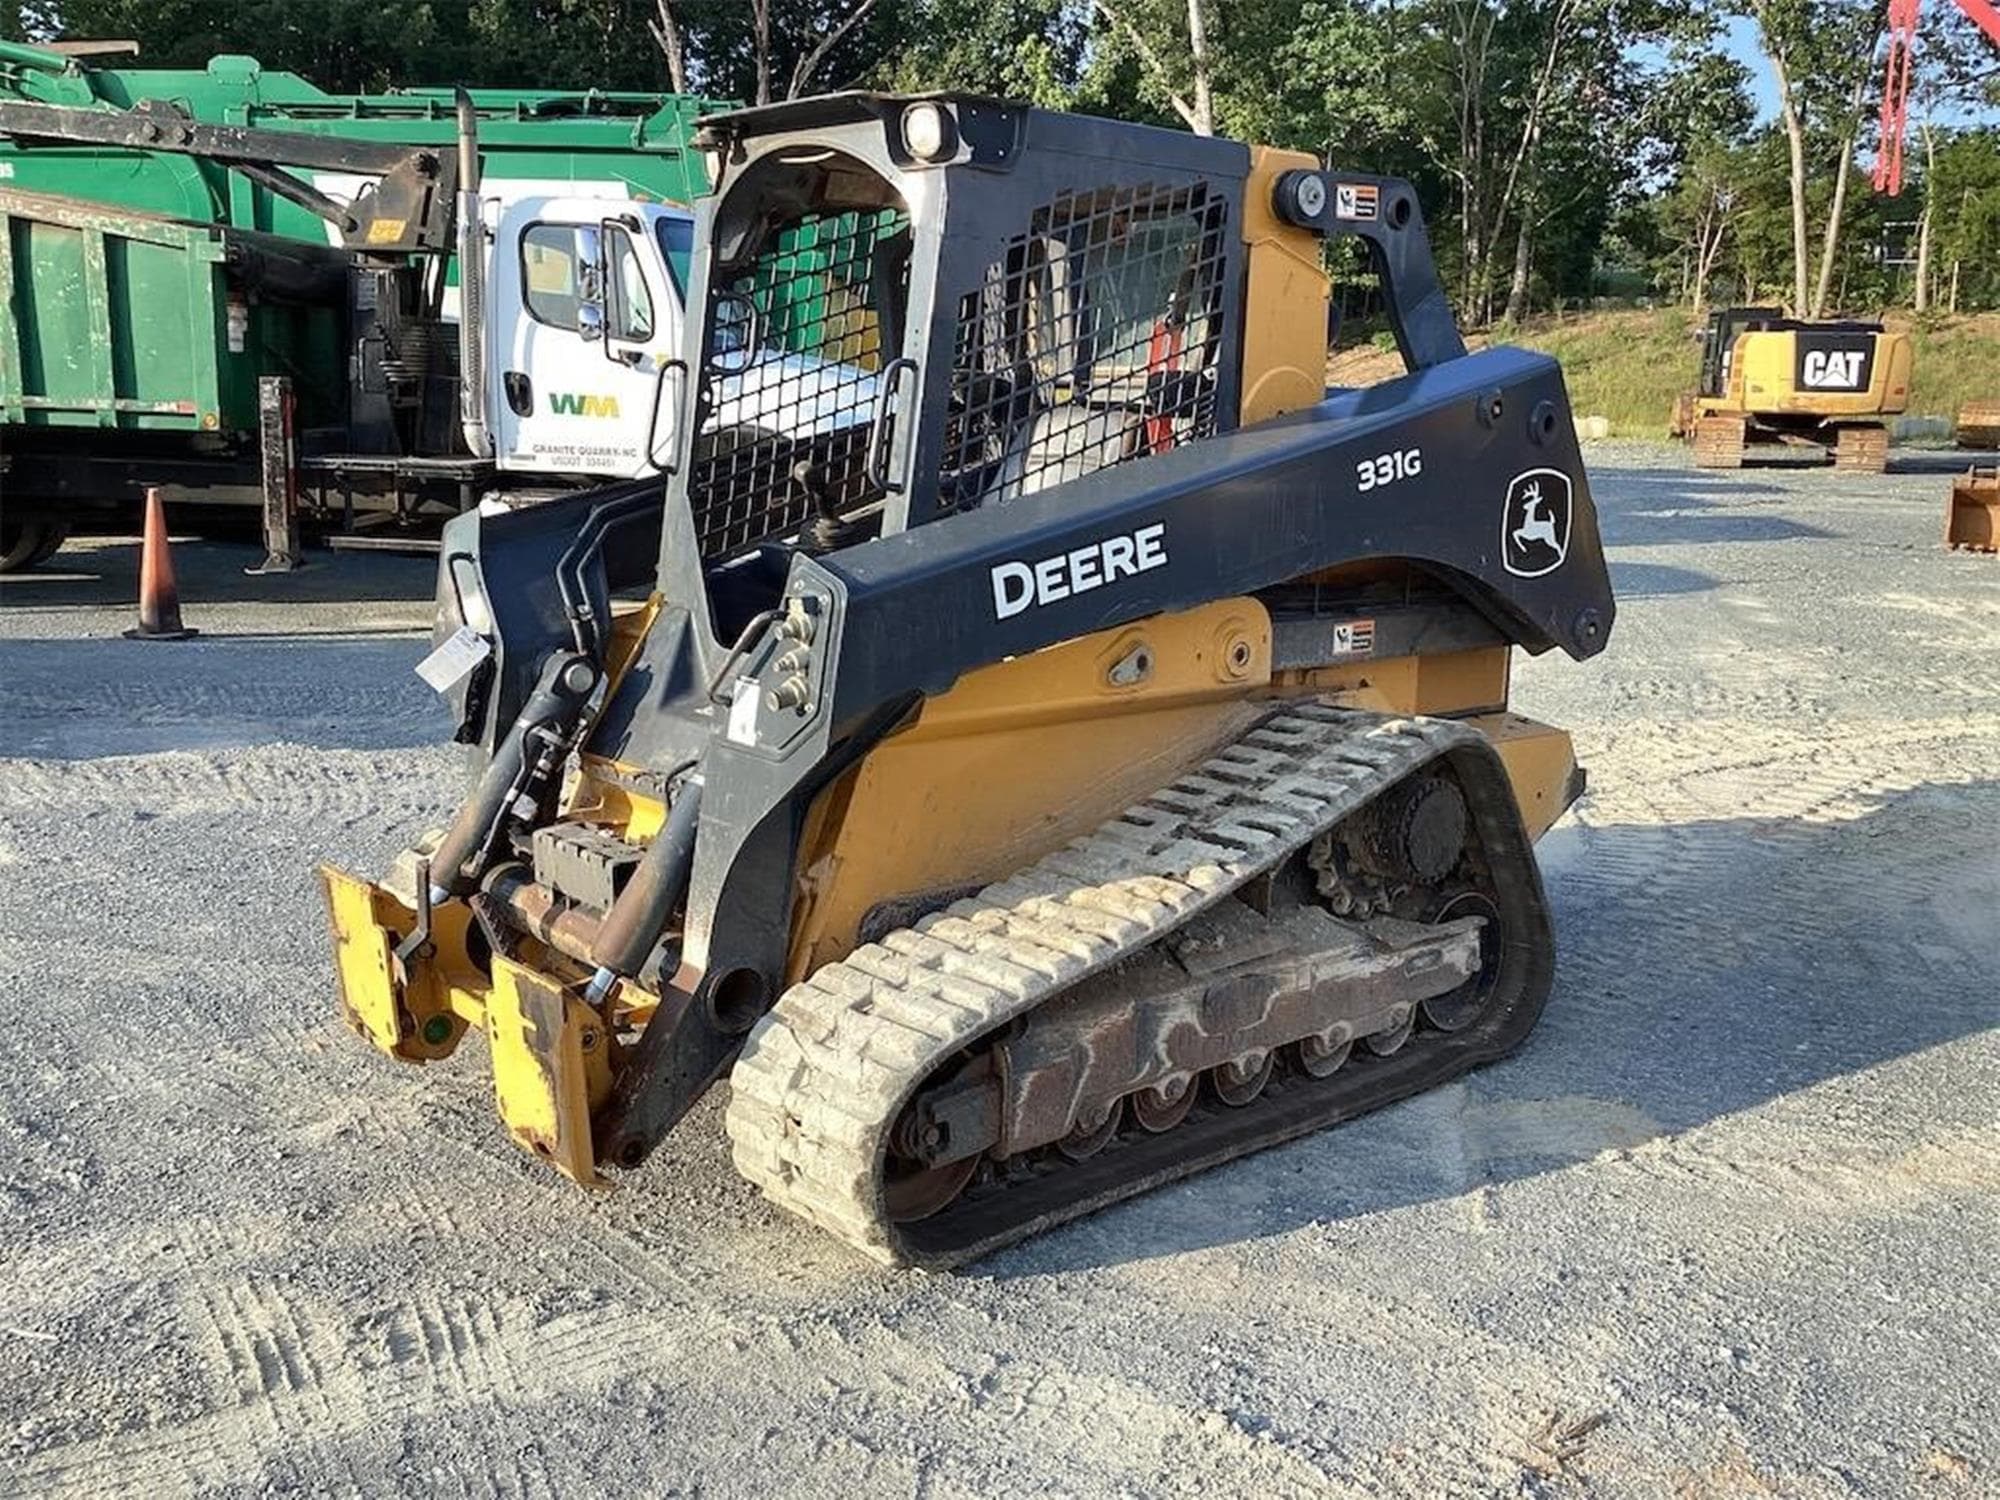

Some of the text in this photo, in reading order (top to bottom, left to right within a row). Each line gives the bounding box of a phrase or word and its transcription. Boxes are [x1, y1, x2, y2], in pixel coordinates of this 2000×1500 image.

[1803, 351, 1865, 387] CAT
[549, 393, 620, 418] WM
[532, 444, 575, 455] GRANITE
[1357, 449, 1421, 492] 331G
[991, 523, 1168, 620] DEERE
